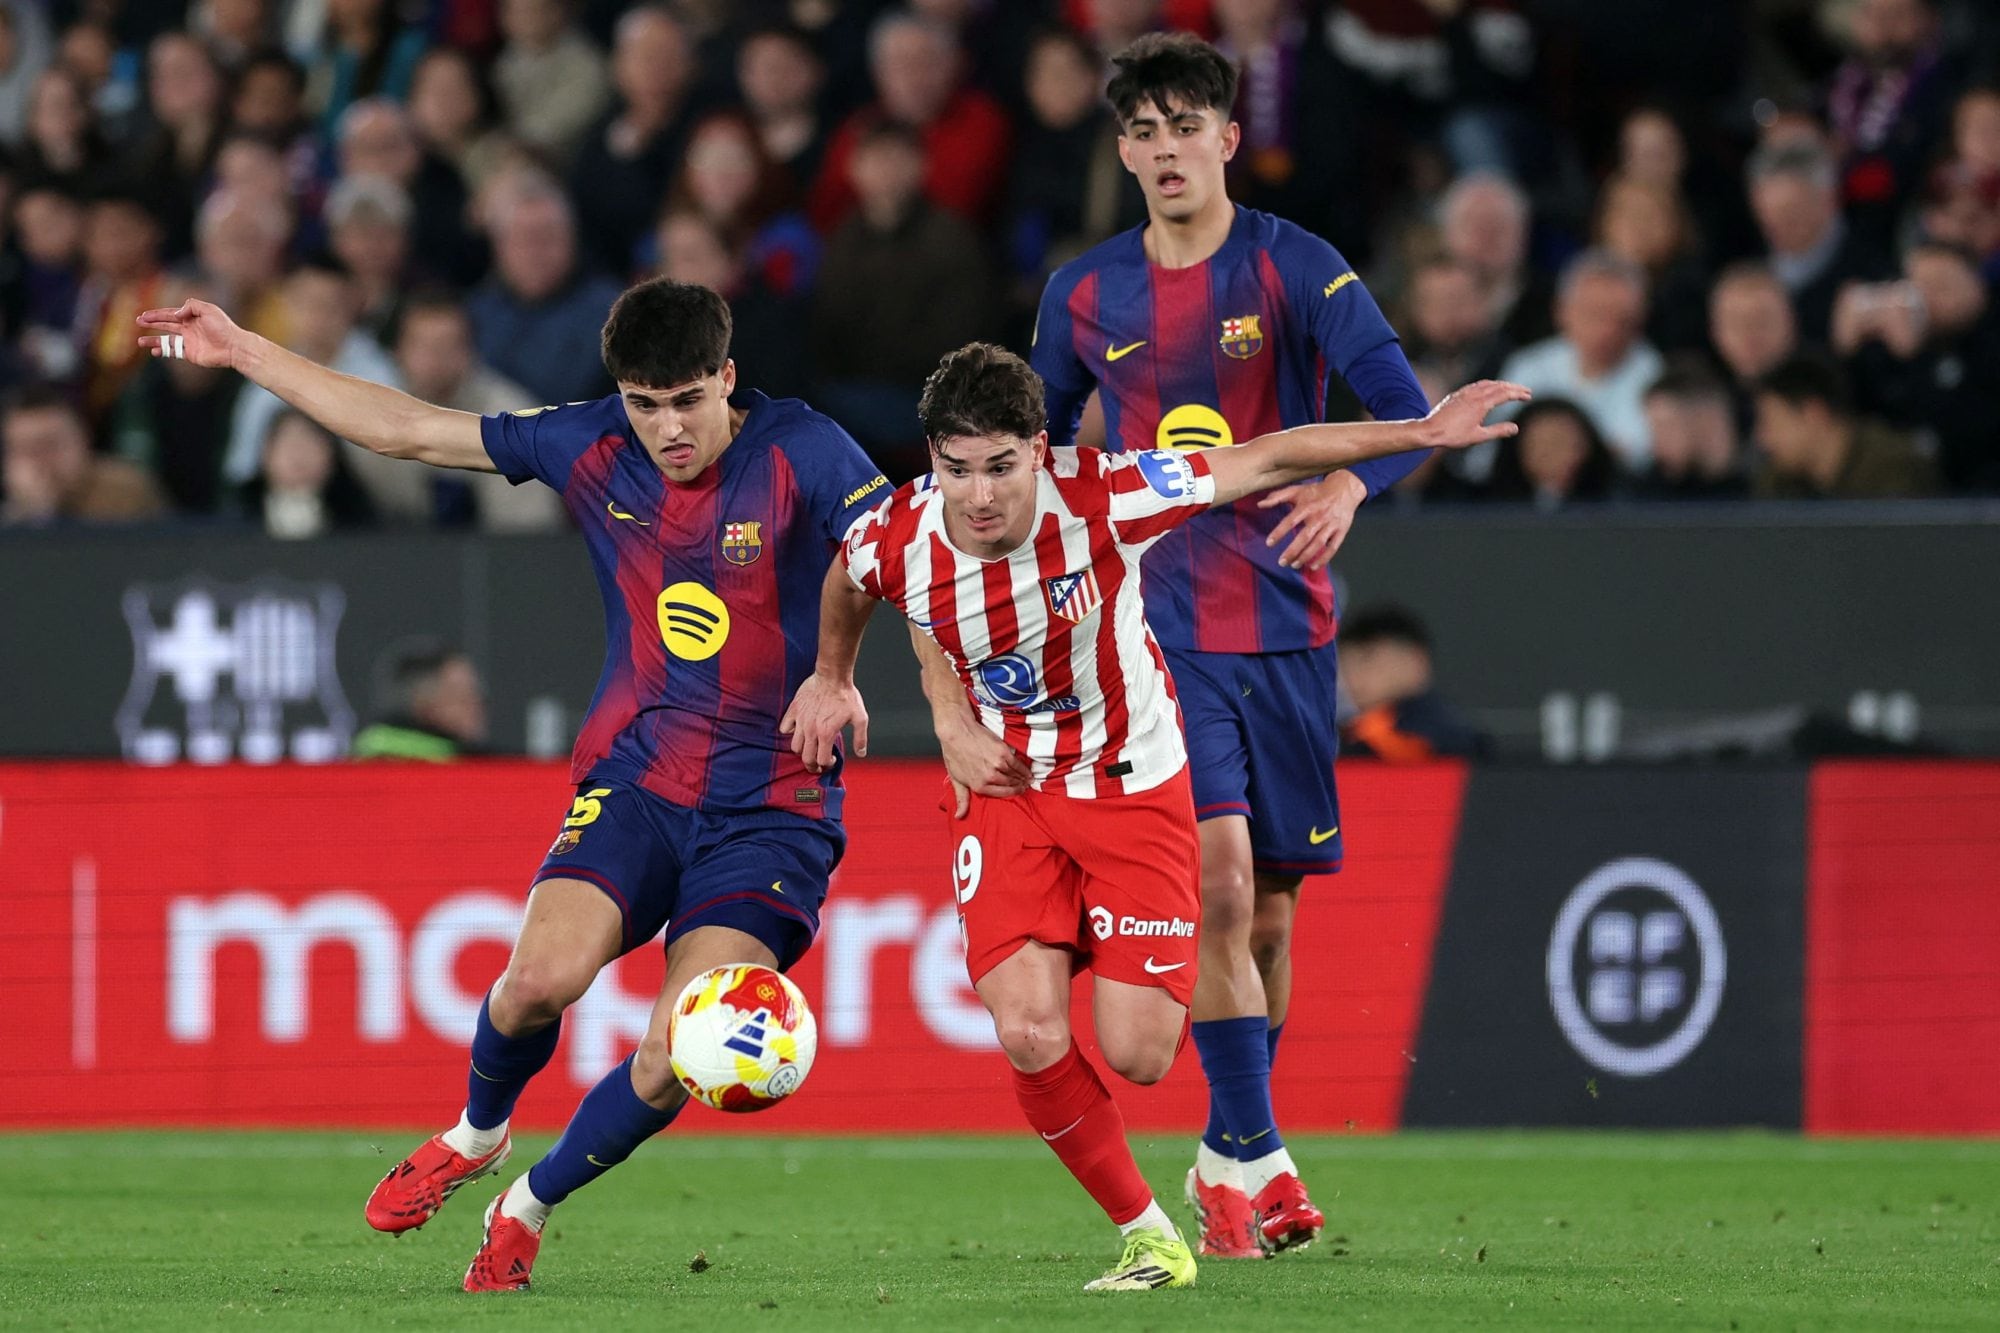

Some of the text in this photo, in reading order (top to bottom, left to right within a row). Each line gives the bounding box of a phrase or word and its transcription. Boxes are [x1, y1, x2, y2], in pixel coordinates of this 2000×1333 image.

[564, 788, 612, 828] 5
[953, 834, 982, 904] 9
[1119, 916, 1195, 937] ComAve
[166, 888, 1005, 1087] mare
